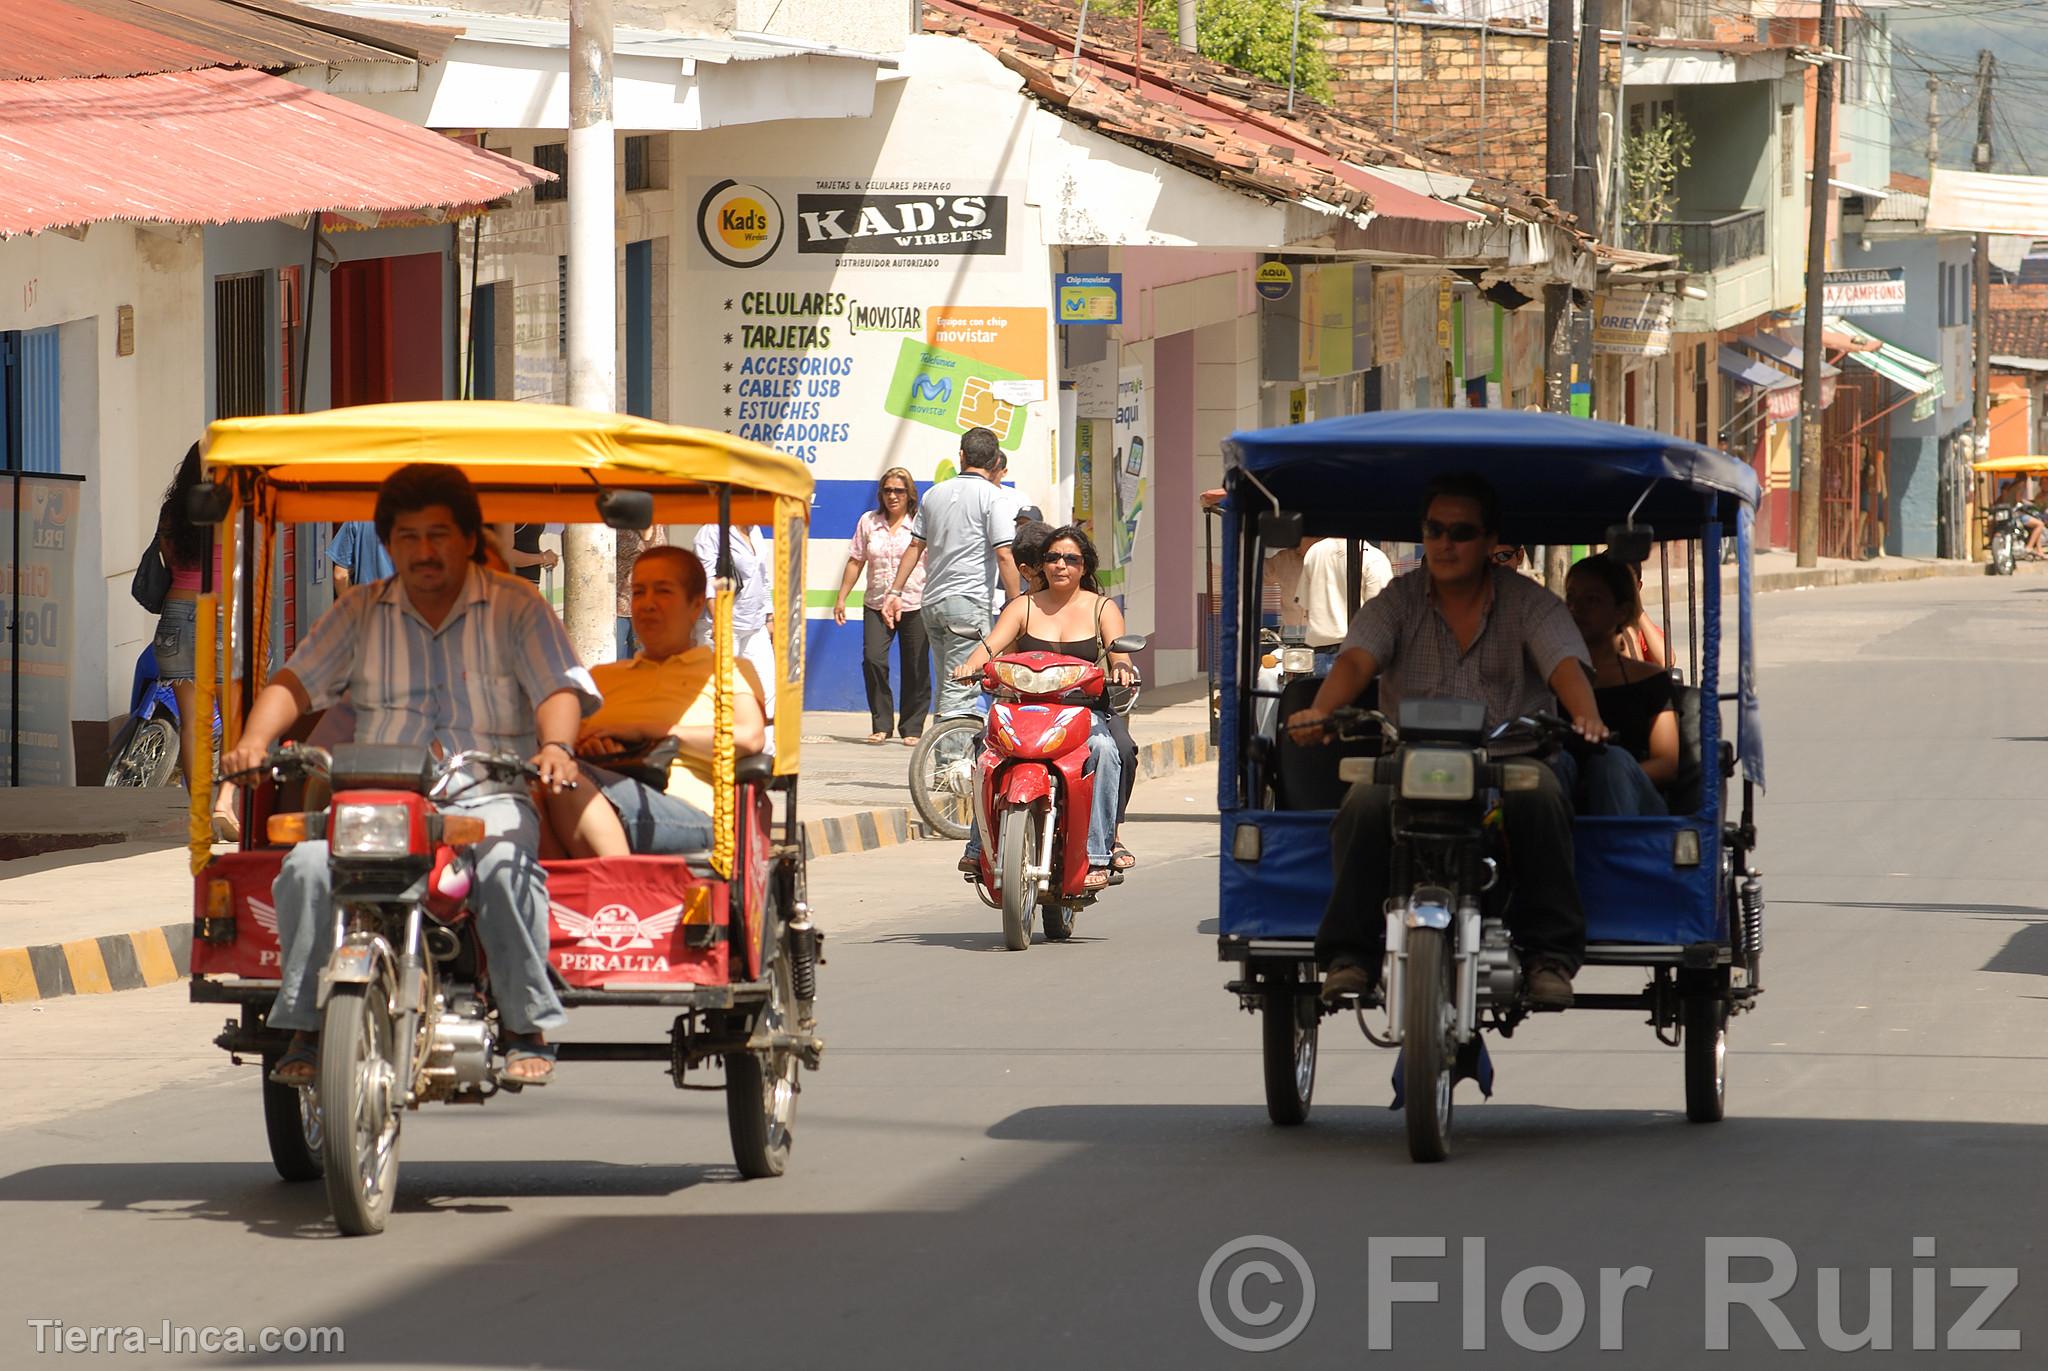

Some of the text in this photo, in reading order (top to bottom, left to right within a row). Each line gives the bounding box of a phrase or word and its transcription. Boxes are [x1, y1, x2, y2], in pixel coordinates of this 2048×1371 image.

[816, 180, 850, 190] TARJETAS
[865, 181, 909, 191] CELULARES
[912, 181, 951, 191] PREPAGO
[722, 209, 766, 231] Kad's
[800, 196, 986, 242] KAD'S
[894, 228, 992, 247] WIRELESS
[835, 258, 939, 268] DISTRIBUIDOR AUTORIZADO
[1824, 270, 1891, 283] APATERIA
[741, 291, 846, 316] CELULARES
[855, 306, 921, 329] MOVISTAR
[986, 317, 1008, 328] chip
[741, 325, 830, 349] TARJETAS
[936, 328, 998, 343] movistar
[740, 356, 854, 376] ACCESORIOS
[738, 379, 841, 398] CABLES USB
[738, 401, 820, 420] ESTUCHES
[739, 423, 850, 442] CARGADORES
[559, 953, 670, 972] PERALTA
